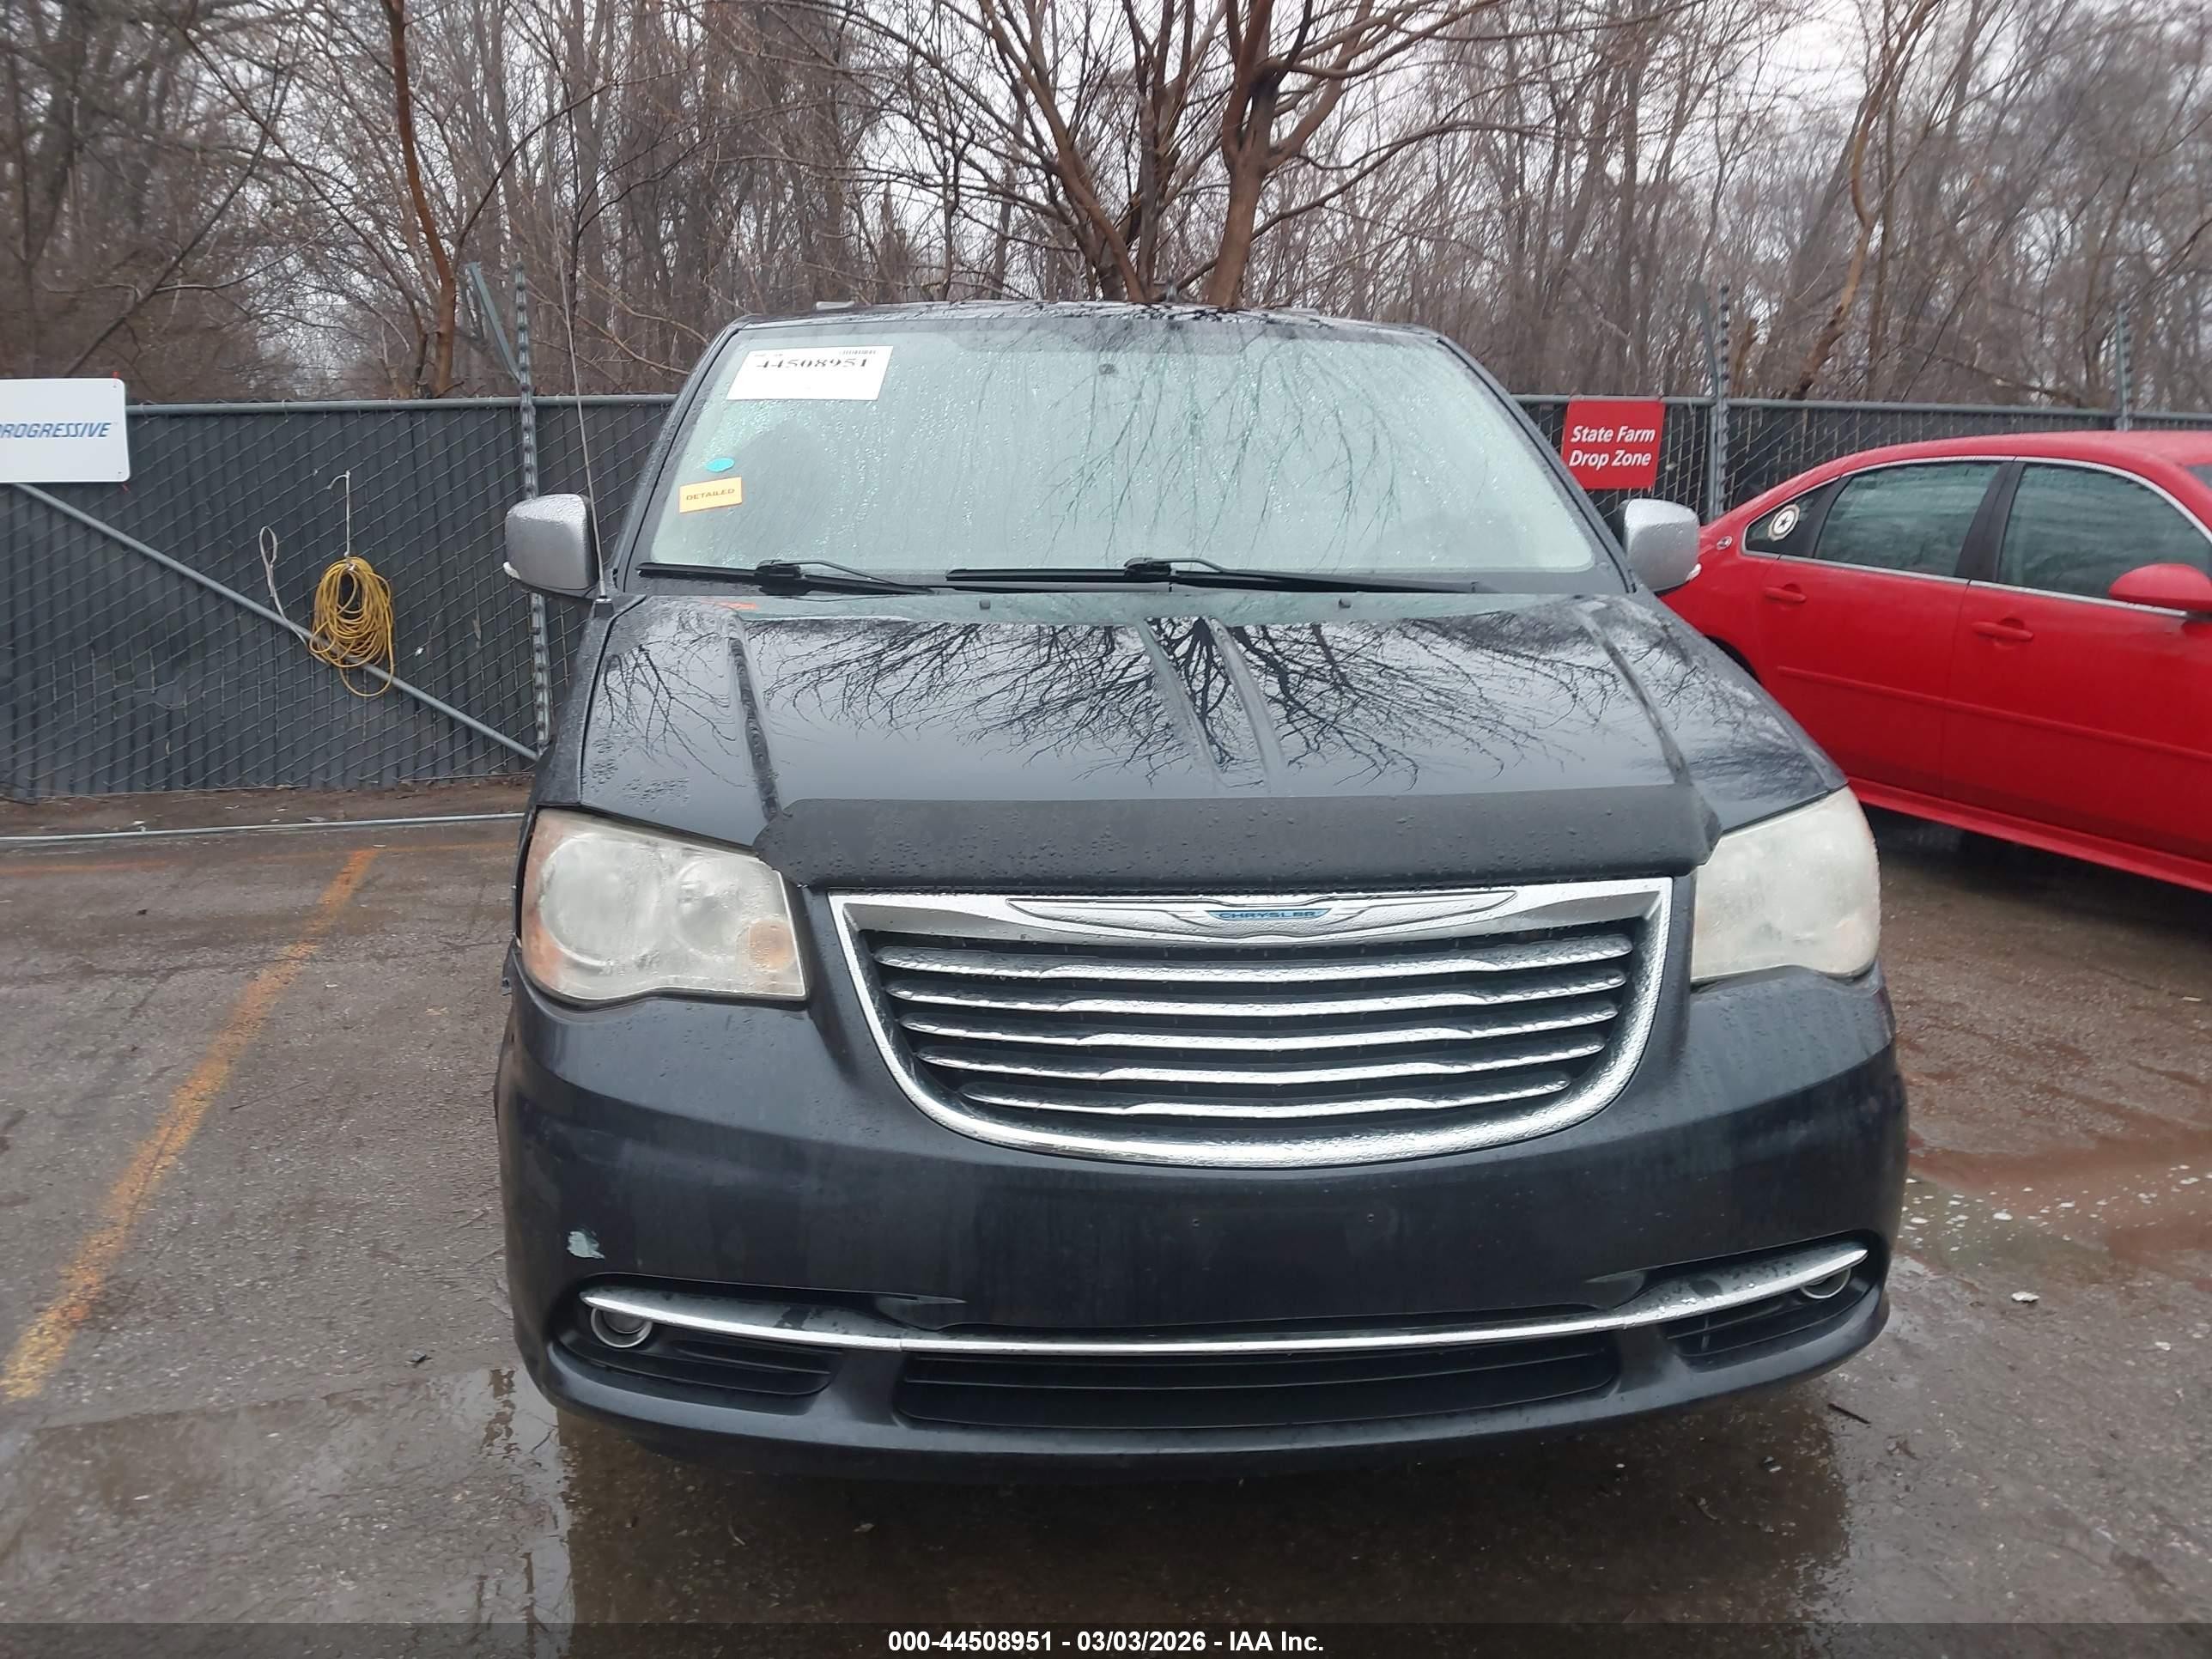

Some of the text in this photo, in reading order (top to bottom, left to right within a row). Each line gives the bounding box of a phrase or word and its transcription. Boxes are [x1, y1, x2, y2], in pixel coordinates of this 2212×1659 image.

[0, 422, 112, 438] ROGRESSIVE
[1571, 425, 1656, 443] State Farm
[1568, 449, 1652, 471] Drop Zone
[686, 488, 736, 501] DETAILED
